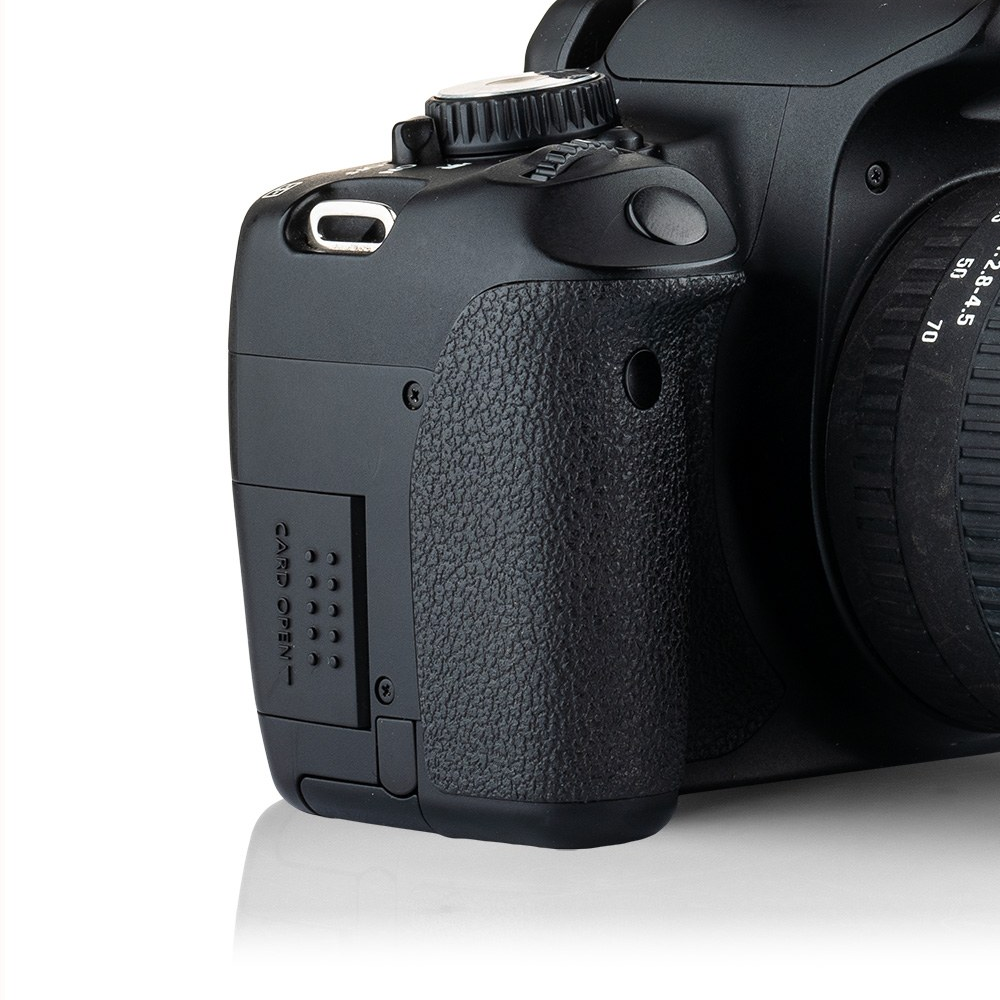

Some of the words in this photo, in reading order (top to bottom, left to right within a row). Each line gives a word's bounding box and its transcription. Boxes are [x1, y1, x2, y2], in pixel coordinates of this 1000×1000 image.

[950, 257, 975, 279] 50
[922, 319, 943, 343] 70
[275, 521, 289, 588] CARD
[277, 597, 292, 661] OPEN
